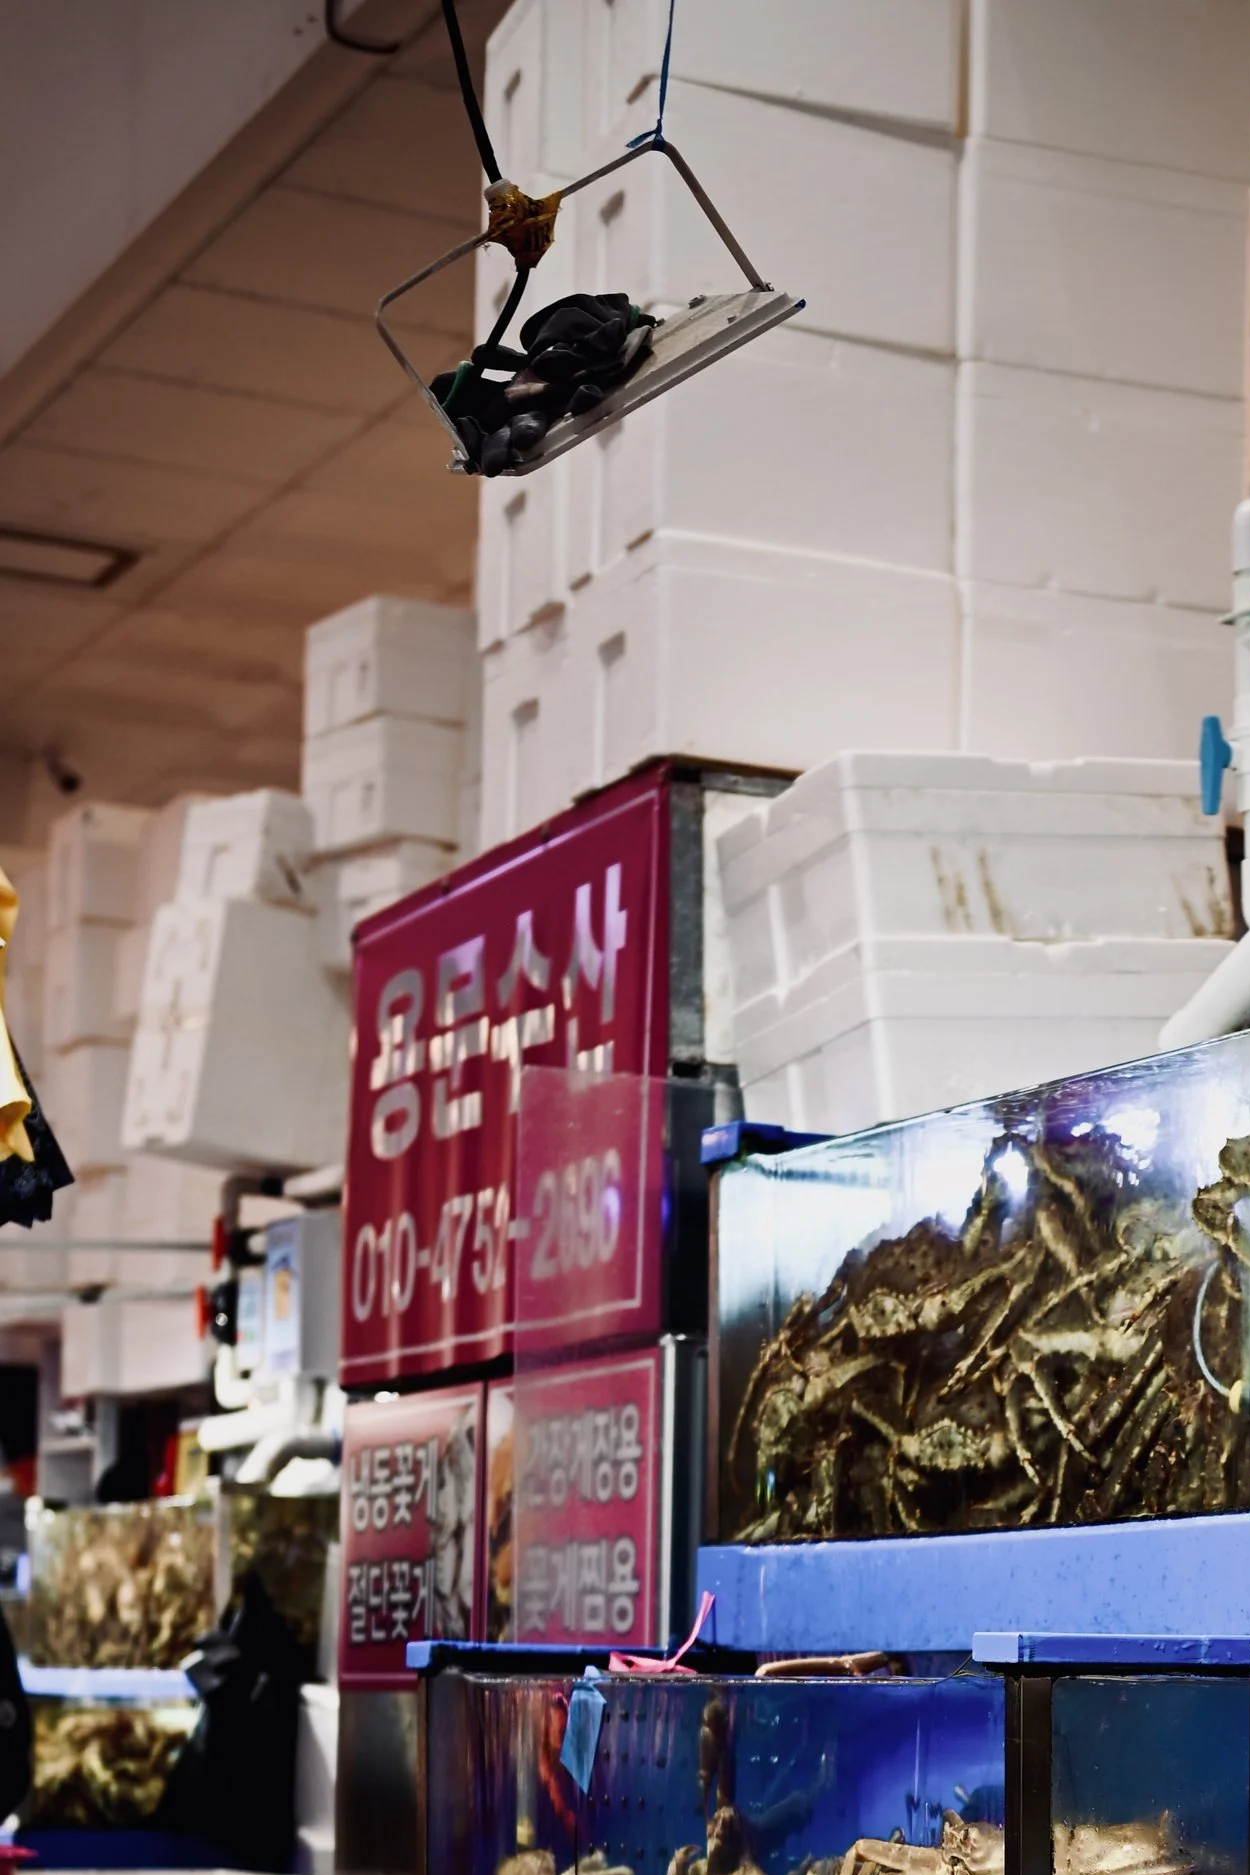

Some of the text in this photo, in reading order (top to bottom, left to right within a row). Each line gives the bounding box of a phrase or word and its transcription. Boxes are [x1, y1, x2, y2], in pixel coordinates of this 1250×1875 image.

[369, 862, 628, 1161] 용문수산
[350, 1437, 438, 1533] 냉동꽃게
[348, 1559, 437, 1643] 절단꽃게
